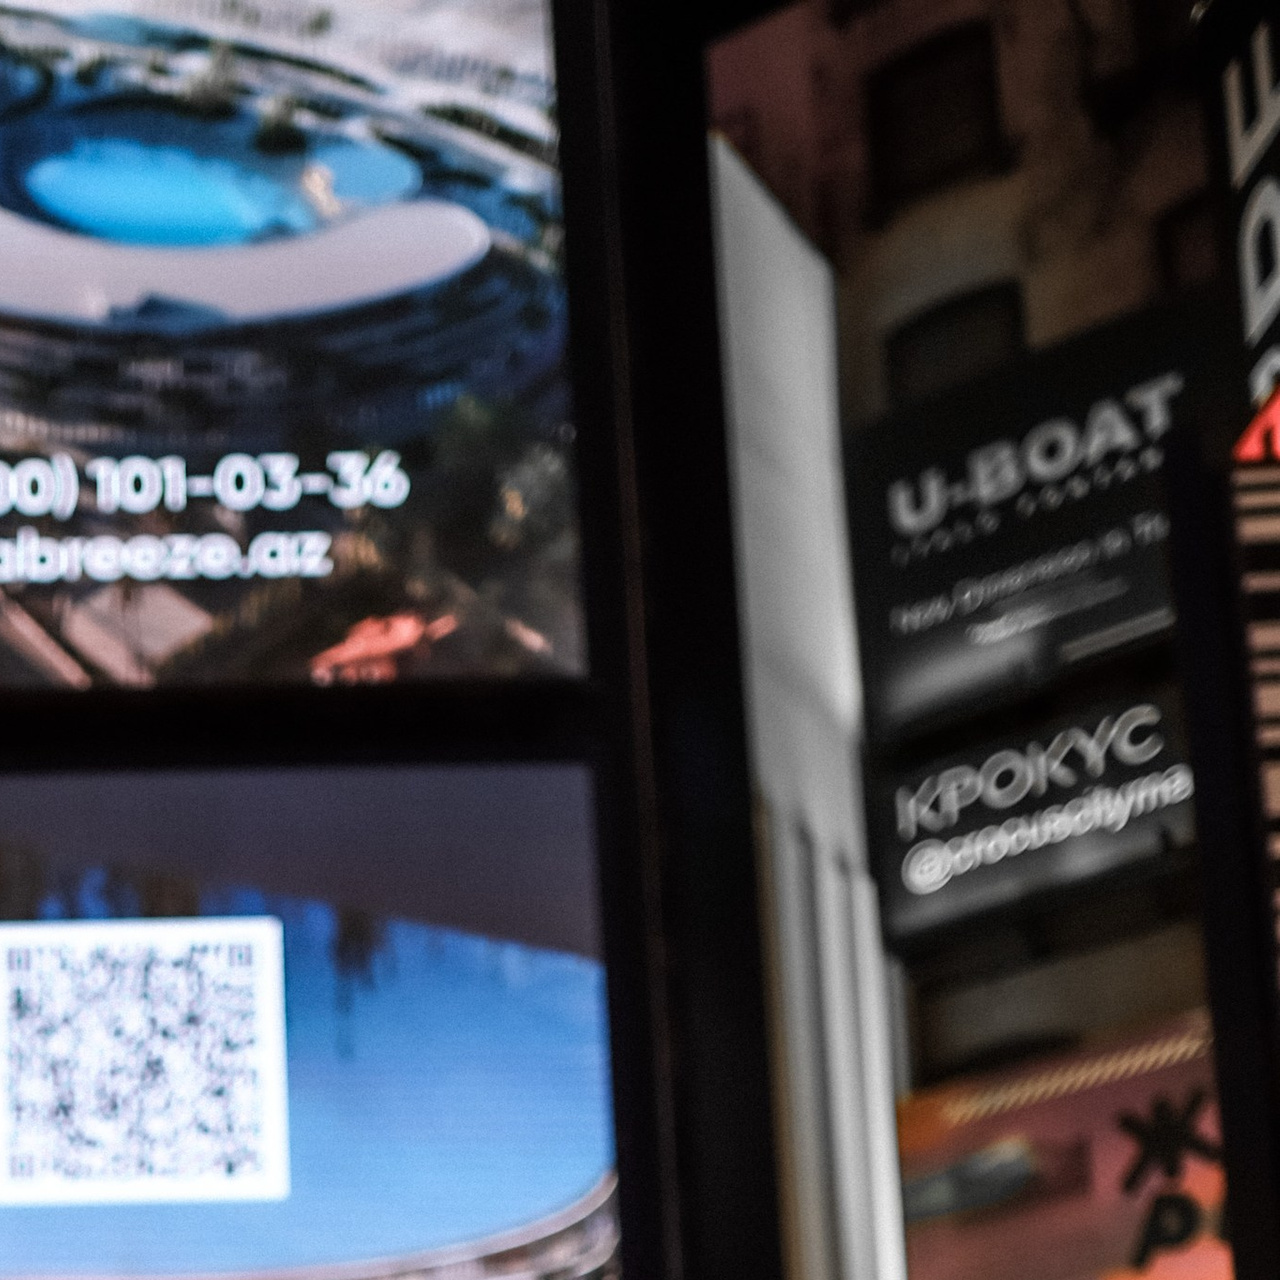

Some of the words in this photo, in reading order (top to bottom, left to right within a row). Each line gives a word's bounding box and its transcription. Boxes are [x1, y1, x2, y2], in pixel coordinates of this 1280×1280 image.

[85, 450, 410, 514] 101-03-36
[888, 371, 1185, 536] U-BOAT
[895, 703, 1165, 843] КРОКУС
